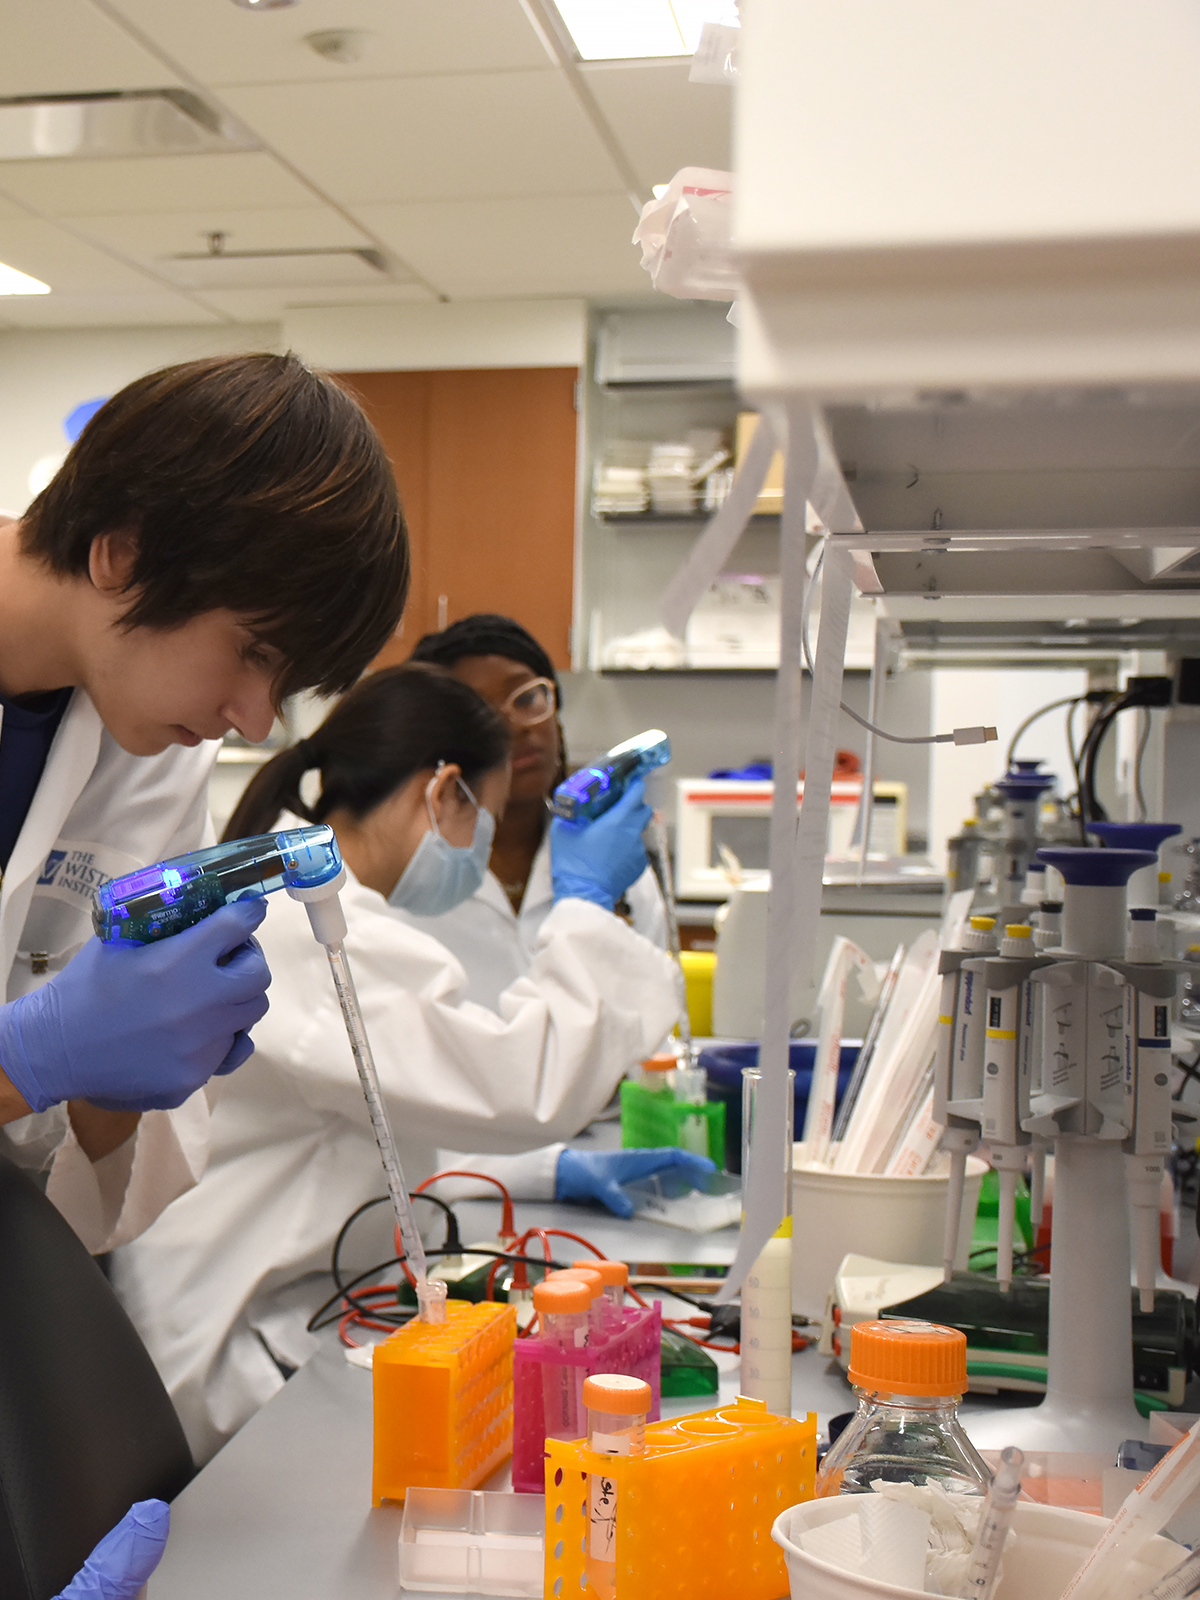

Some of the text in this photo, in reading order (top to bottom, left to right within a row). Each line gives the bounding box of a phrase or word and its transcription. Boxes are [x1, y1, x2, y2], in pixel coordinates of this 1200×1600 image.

[71, 851, 96, 865] THE
[65, 861, 113, 887] WIST
[58, 876, 99, 900] INSTIT
[963, 971, 974, 1016] eppendorf
[1144, 1165, 1161, 1173] 1000
